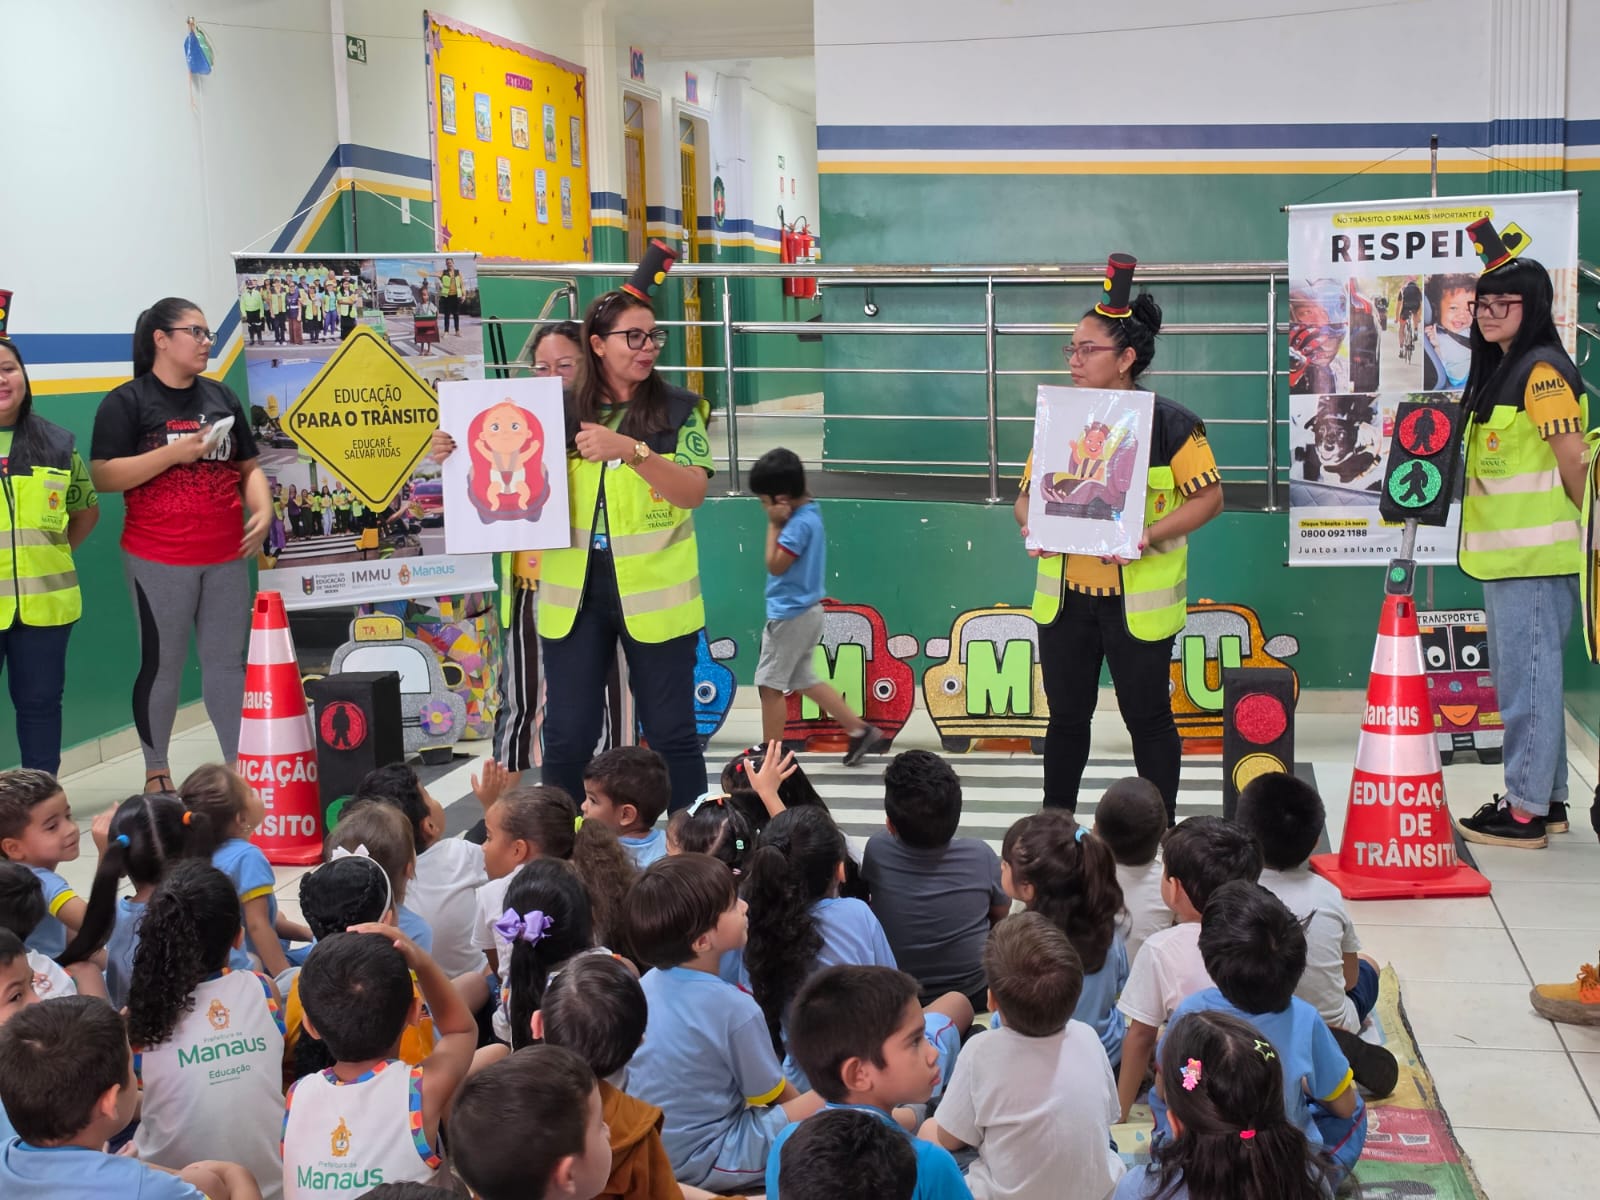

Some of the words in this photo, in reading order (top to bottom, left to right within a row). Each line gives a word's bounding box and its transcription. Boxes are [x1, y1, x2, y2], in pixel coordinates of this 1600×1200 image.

[1414, 213, 1431, 221] MAIS
[1432, 211, 1477, 220] IMPORTANTE
[1332, 230, 1463, 262] RESPEI
[334, 384, 402, 405] EDUCAÇÃO
[1532, 379, 1565, 395] IMMU
[297, 411, 342, 428] PARA
[345, 410, 358, 427] O
[361, 404, 438, 426] TRÂNSITO
[352, 438, 386, 450] EDUCAR
[387, 436, 393, 448] É
[344, 448, 376, 460] SALVAR
[376, 447, 401, 458] VIDAS
[1301, 529, 1326, 538] 0800
[1327, 529, 1345, 537] 092
[1347, 528, 1367, 537] 1188
[1298, 546, 1337, 554] Juntos
[1344, 544, 1398, 553] salvamos
[351, 568, 391, 583] IMMU
[412, 563, 455, 577] Manaus
[1416, 612, 1480, 625] TRANSPORTE
[966, 639, 1033, 716] M
[236, 757, 318, 787] UCAÇÃO
[1353, 781, 1448, 811] EDUCAÇ
[1400, 813, 1432, 837] DE
[178, 1036, 267, 1068] Manaus
[209, 1064, 251, 1079] Educação
[297, 1165, 383, 1190] Manaus
